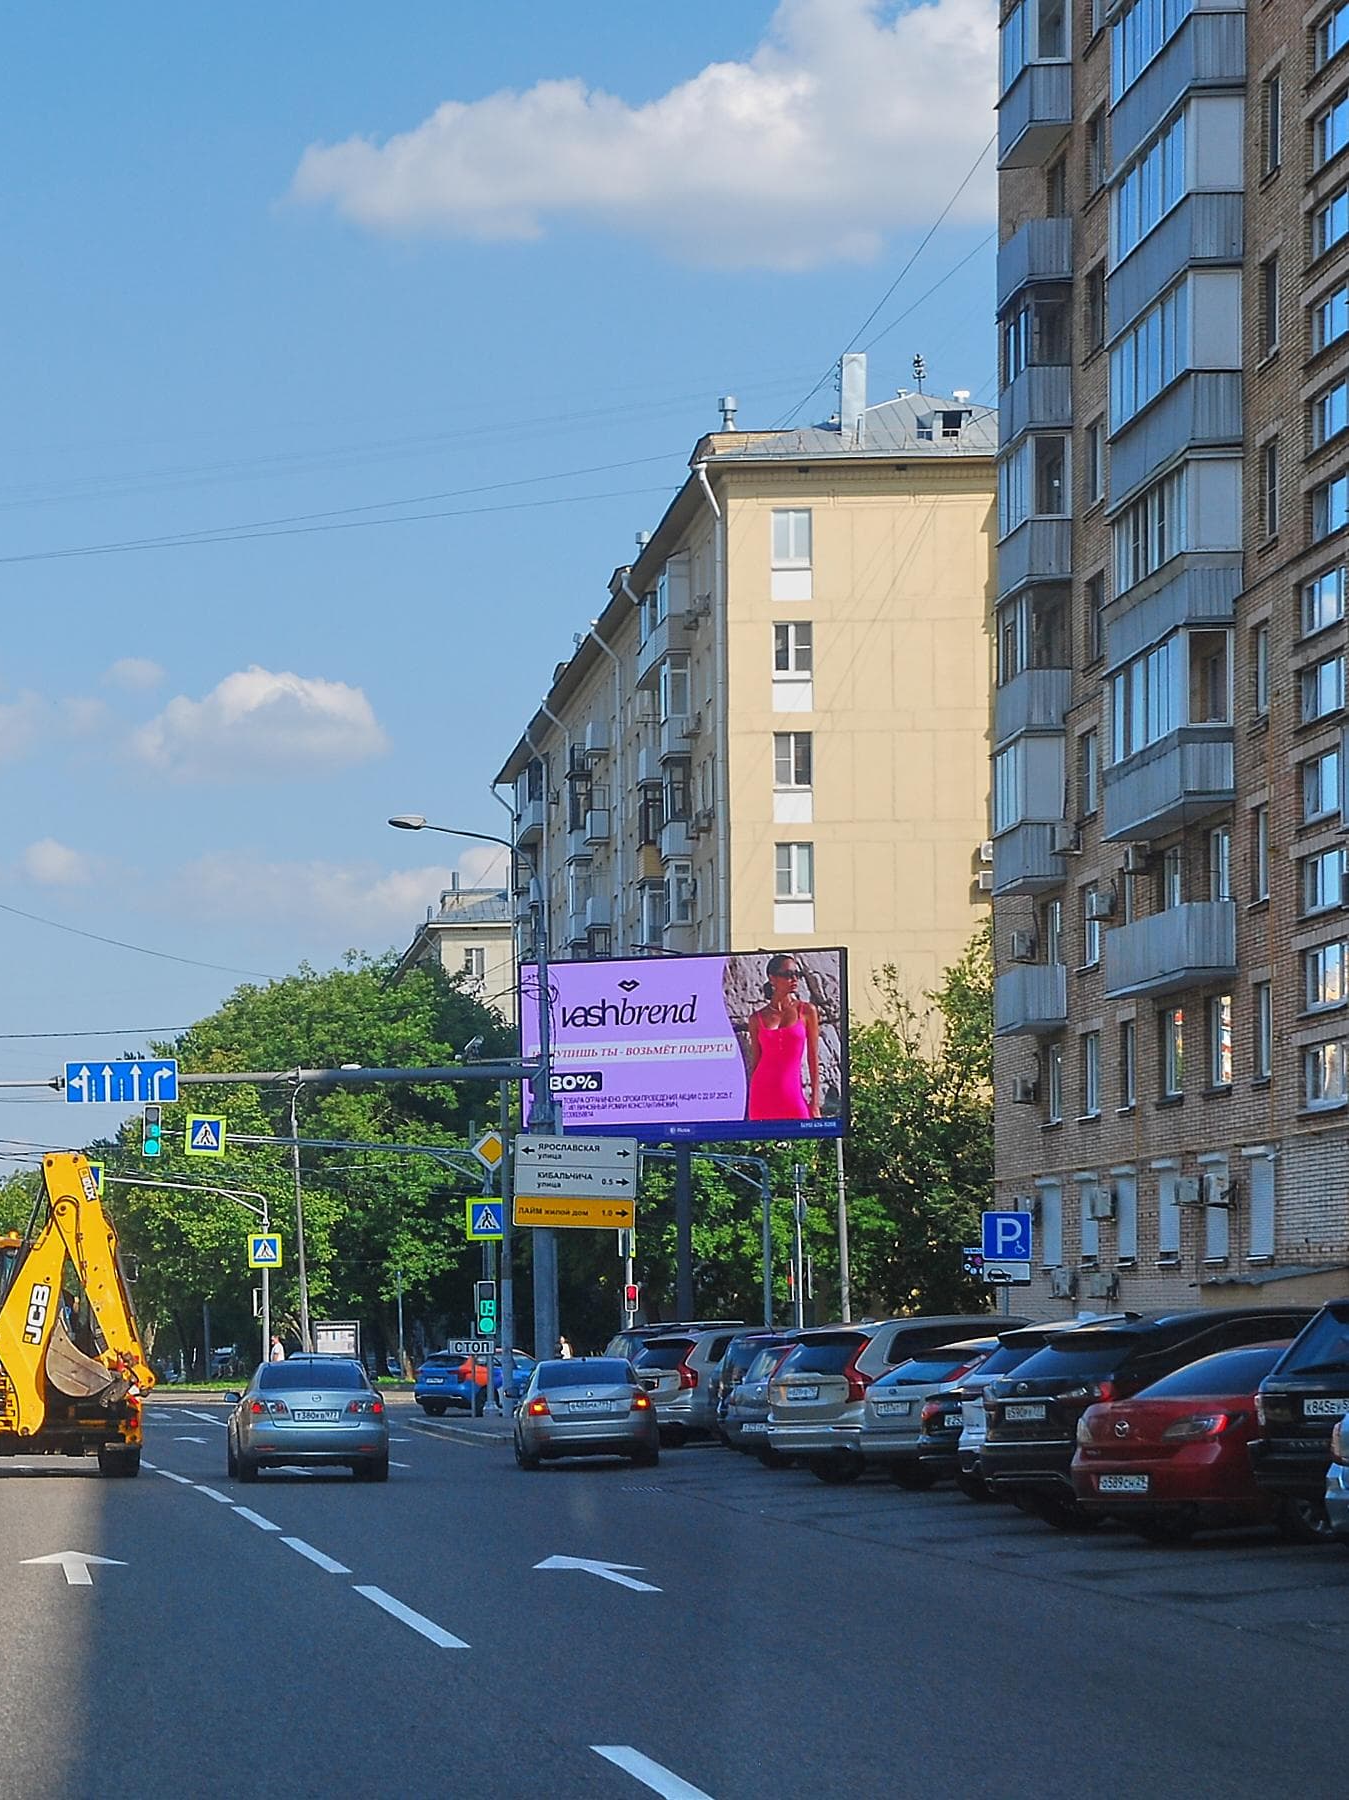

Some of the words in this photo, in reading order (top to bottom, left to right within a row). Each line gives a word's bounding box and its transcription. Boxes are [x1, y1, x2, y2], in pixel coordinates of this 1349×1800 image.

[562, 995, 697, 1027] vashbrend
[554, 1048, 598, 1058] УПИШЬ
[601, 1048, 618, 1056] ТЫ
[679, 1043, 733, 1054] ПОДРУГА!
[538, 1143, 600, 1152] ЯРОСЛАВСКАЯ
[537, 1171, 593, 1180] КИБАЛЬЧИЧА
[997, 1218, 1022, 1254] P
[24, 1284, 50, 1345] JCB
[455, 1342, 490, 1352] СТОП
